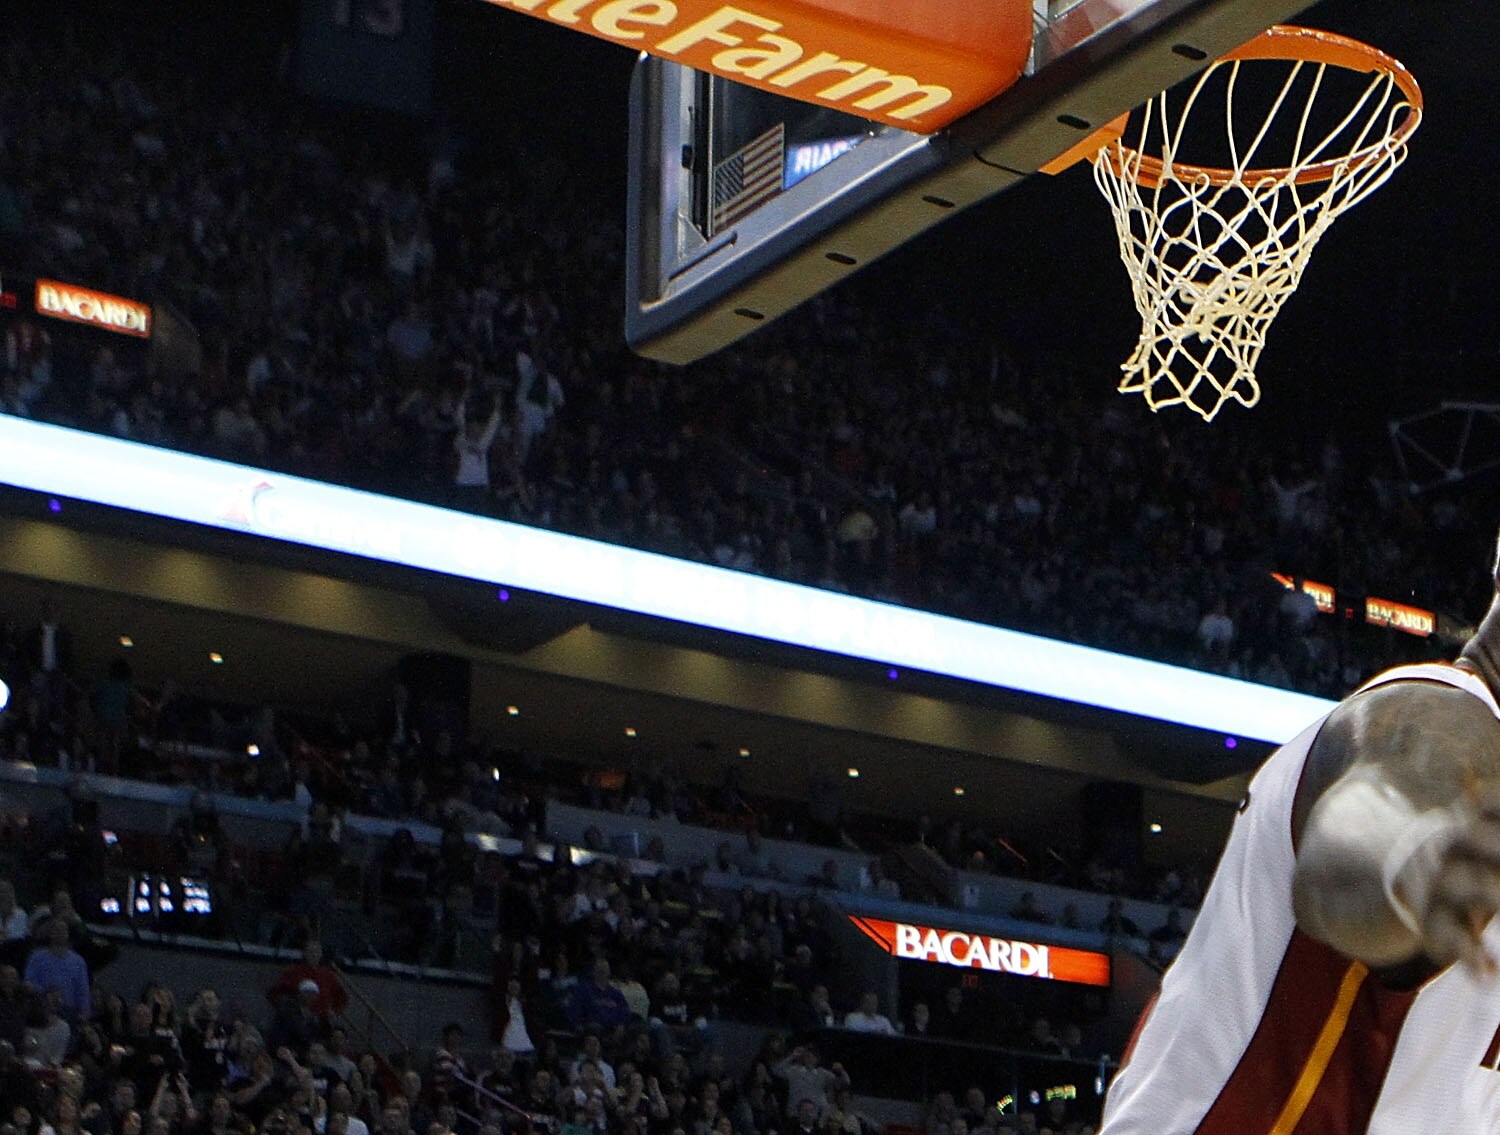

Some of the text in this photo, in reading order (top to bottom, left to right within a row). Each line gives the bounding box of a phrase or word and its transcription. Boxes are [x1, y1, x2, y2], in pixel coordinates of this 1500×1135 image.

[656, 6, 952, 121] Farm
[40, 285, 147, 332] BACARDI
[1366, 603, 1433, 633] BACARDI
[896, 924, 1051, 979] BACARDI
